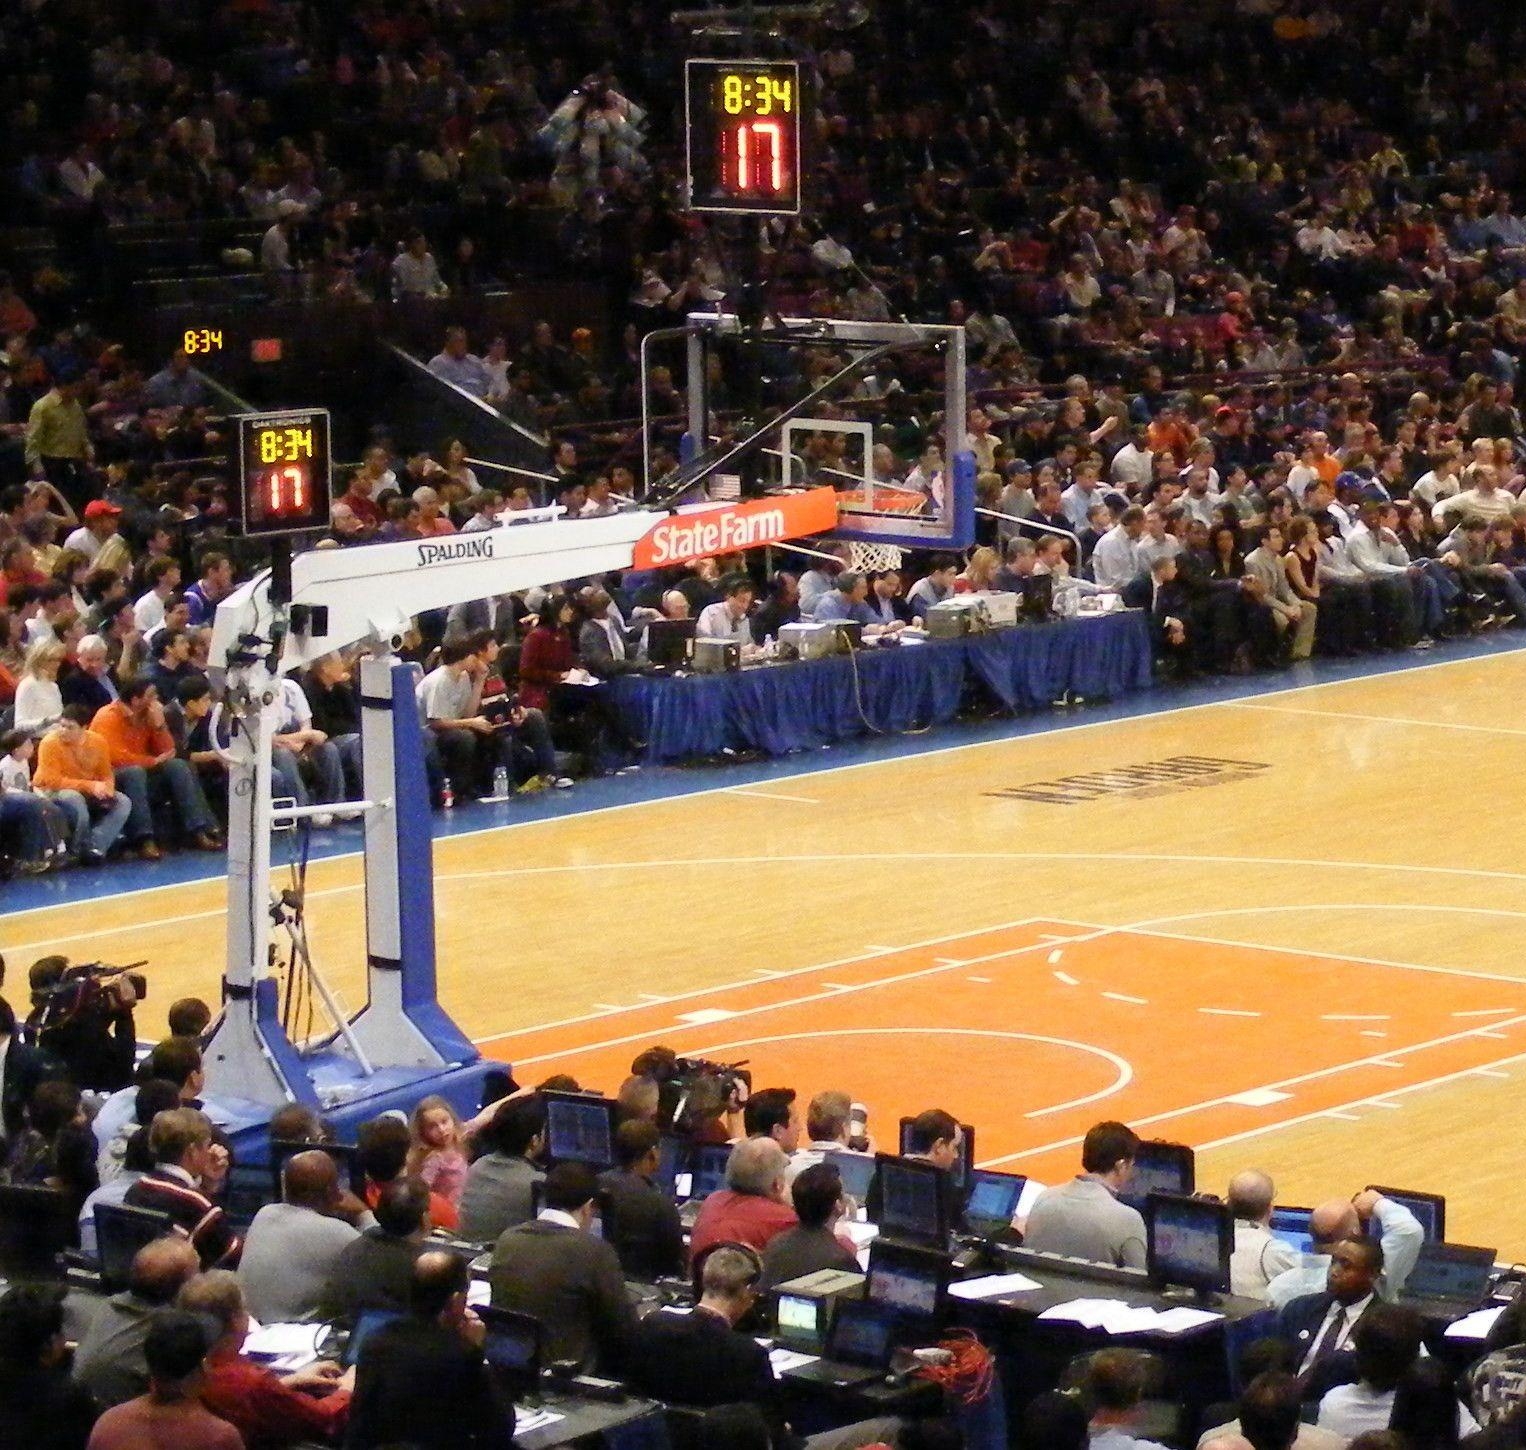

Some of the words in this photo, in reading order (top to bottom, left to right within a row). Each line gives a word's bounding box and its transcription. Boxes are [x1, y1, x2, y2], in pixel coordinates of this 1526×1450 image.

[723, 74, 792, 116] 8:34
[737, 123, 781, 191] 17
[184, 329, 223, 354] 8:34
[260, 428, 313, 463] 8:34
[270, 466, 302, 510] 17
[416, 536, 494, 567] SPALDING
